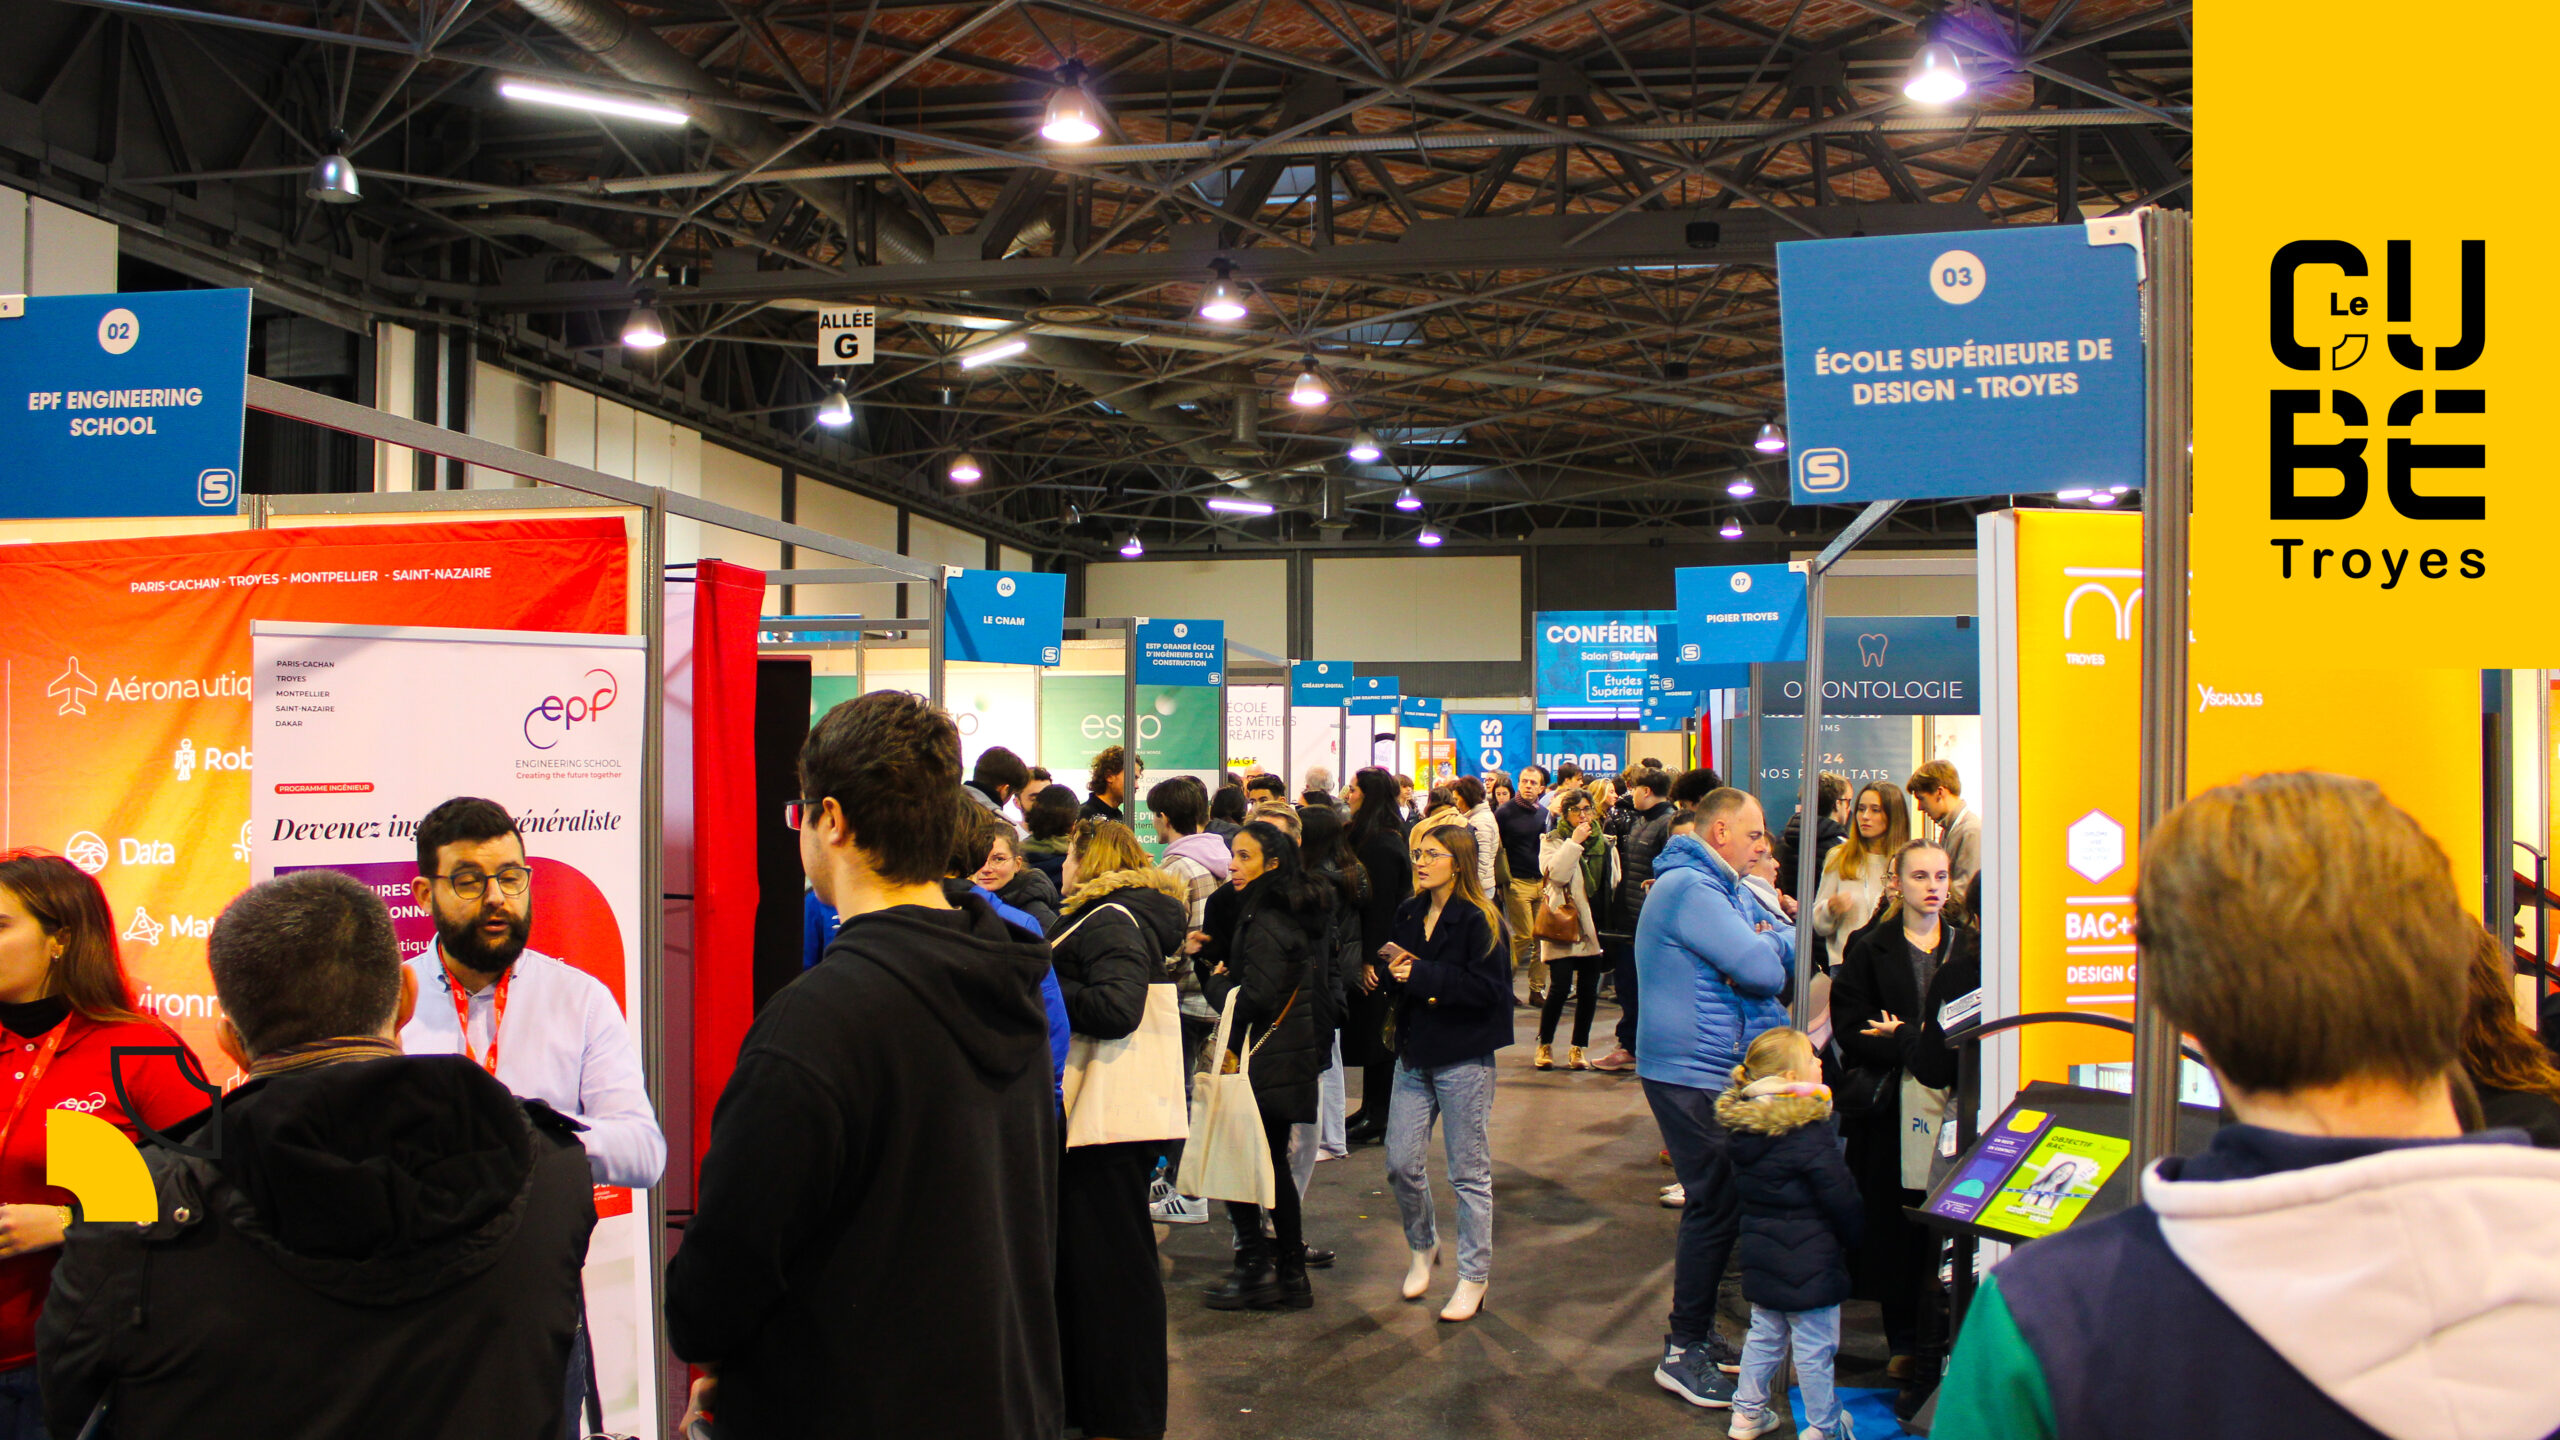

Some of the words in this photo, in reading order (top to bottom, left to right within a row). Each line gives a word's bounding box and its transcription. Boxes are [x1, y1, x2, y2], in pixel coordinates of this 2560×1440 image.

[1942, 267, 1973, 287] 03
[820, 308, 874, 329] ALLÉE
[107, 321, 130, 341] 02
[834, 333, 858, 359] G
[1815, 347, 1902, 375] ÉCOLE
[1910, 339, 2069, 370] SUPÉRIEURE
[2078, 338, 2113, 360] DE
[1853, 379, 1955, 405] DESIGN
[1977, 372, 2079, 398] TROYES
[28, 392, 61, 411] EPF
[66, 387, 203, 410] ENGINEERING
[70, 417, 157, 437] SCHOOL
[130, 577, 220, 594] PARIS-CACHAN
[229, 573, 280, 587] TROYES
[290, 570, 378, 584] MONTPELLIER
[392, 567, 492, 581] SAINT-NAZAIRE
[1001, 582, 1012, 592] 06
[1734, 578, 1747, 587] 07
[983, 615, 994, 625] LE
[995, 615, 1025, 626] CNAM
[1706, 614, 1739, 623] PIGIER
[1741, 612, 1779, 622] TROYES
[1192, 642, 1215, 651] ÉCOLE
[1152, 659, 1207, 667] CONSTRUCTION
[1581, 651, 1608, 661] Salon
[2066, 653, 2105, 665] TROYES
[276, 660, 335, 668] PARIS-CACHAN
[1604, 673, 1642, 687] Études
[276, 690, 331, 698] MONTPELLIER
[1783, 681, 1963, 699] OONTOLOGIE
[524, 668, 617, 749] epf
[515, 759, 582, 768] ENGINEERING
[584, 759, 622, 768] SCHOOL
[516, 772, 551, 780] Creating
[279, 784, 328, 792] PROGRAMME
[329, 782, 370, 792] INGÉNIEUR
[272, 818, 383, 842] Devenez
[513, 808, 622, 834] énéraliste
[120, 838, 175, 865] Data
[2067, 965, 2124, 983] DESIGN
[2051, 1135, 2094, 1148] OBJECTIF
